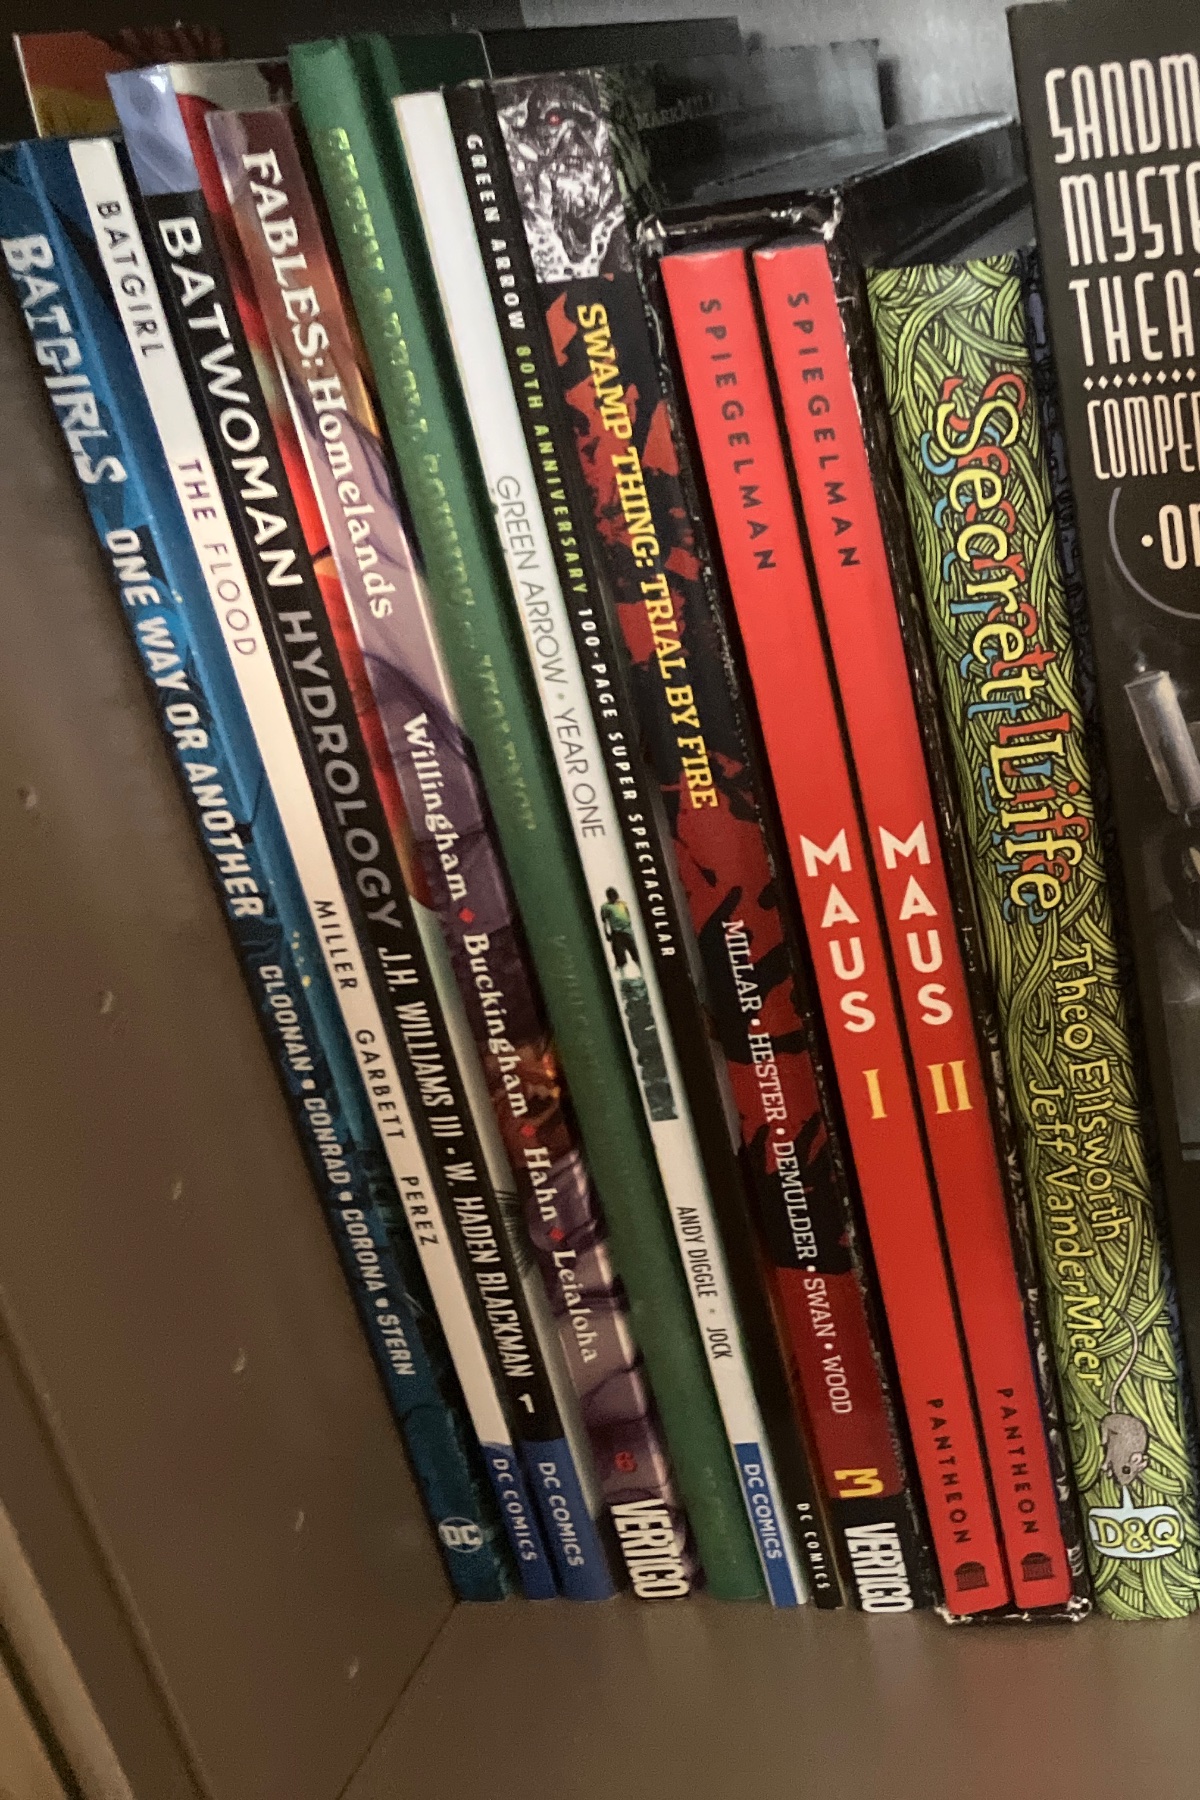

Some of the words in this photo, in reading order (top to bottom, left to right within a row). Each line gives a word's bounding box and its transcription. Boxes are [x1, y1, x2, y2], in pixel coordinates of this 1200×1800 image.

[97, 200, 164, 357] BATGIRL
[1, 233, 128, 485] BATGIRLS
[242, 148, 331, 369] FABLES:
[308, 376, 397, 620] Homelands
[577, 302, 634, 442] SWAMP
[699, 297, 777, 571] SPIEGELMAN
[786, 290, 861, 568] SPIEGELMAN
[178, 458, 218, 521] THE
[203, 541, 258, 657] FLOOD
[467, 133, 500, 223] GREEN
[491, 238, 526, 331] ARROW
[516, 345, 544, 410] 80TH
[533, 424, 588, 594] ANNIVERSARY
[577, 608, 618, 718] 100-PAGE
[608, 732, 637, 801] SUPER
[628, 813, 676, 957] SPECTACULAR
[612, 446, 660, 568] THING:
[933, 396, 1049, 704] Secret
[106, 527, 160, 607] ONE
[158, 215, 304, 587] BATWOMAN
[278, 610, 404, 929] HYDROLOGY
[137, 616, 191, 693] WAY
[495, 475, 539, 572] GREEN
[521, 579, 569, 686] ARROW
[553, 705, 591, 776] YEAR
[572, 782, 606, 838] ONE
[641, 572, 687, 679] TRIAL
[164, 702, 209, 751] OR
[665, 684, 701, 729] BY
[677, 734, 719, 810] FIRE
[989, 733, 1085, 911] Life
[185, 760, 264, 918] ANOTHER
[377, 946, 420, 993] J.H.
[799, 827, 877, 1034] MAUS
[862, 1068, 887, 1120] I
[878, 819, 954, 1027] MAUS
[926, 1059, 974, 1115] II
[1051, 942, 1094, 1051] Theo
[313, 900, 358, 990] MILLER
[354, 1029, 406, 1140] GARBETT
[400, 1174, 440, 1247] PEREZ
[395, 1000, 455, 1109] WILLIAMS
[404, 711, 469, 902] Willingham
[463, 932, 530, 1119] Buckingham
[523, 1146, 559, 1222] Hahn
[552, 1248, 599, 1363] Leialoha
[259, 964, 315, 1073] CLOONAN
[303, 1096, 351, 1186] CONRAD
[341, 1208, 388, 1292] CORONA
[376, 1312, 417, 1377] STERN
[429, 1114, 465, 1139] III
[721, 918, 763, 1014] MILLAR
[748, 1031, 789, 1123] HESTER
[772, 1140, 819, 1261] DEMULDER
[803, 1277, 837, 1338] SWAN
[821, 1353, 854, 1415] WOOD
[1030, 1078, 1077, 1158] Jeff
[1068, 1055, 1134, 1242] Ellsworth
[443, 1160, 478, 1187] W.
[676, 1204, 706, 1245] ANDY
[453, 1195, 502, 1264] HADEN
[687, 1248, 719, 1299] DIGGLE
[475, 1270, 536, 1379] BLACKMAN
[706, 1326, 733, 1360] JOCK
[493, 1458, 514, 1482] DC
[537, 1461, 562, 1489] DC
[743, 1463, 766, 1492] DC
[796, 1501, 814, 1523] DC
[834, 1467, 885, 1499] 3
[926, 1397, 973, 1545] PANTHEON
[996, 1386, 1040, 1535] PANTHEON
[439, 1521, 485, 1551] DC
[503, 1489, 538, 1562] COMICS
[549, 1494, 586, 1567] COMICS
[610, 1498, 690, 1599] VERTIGO
[751, 1494, 783, 1560] COMICS
[804, 1531, 831, 1590] COMICS
[844, 1521, 915, 1613] VERTIGO
[1090, 1513, 1182, 1554] D&Q
